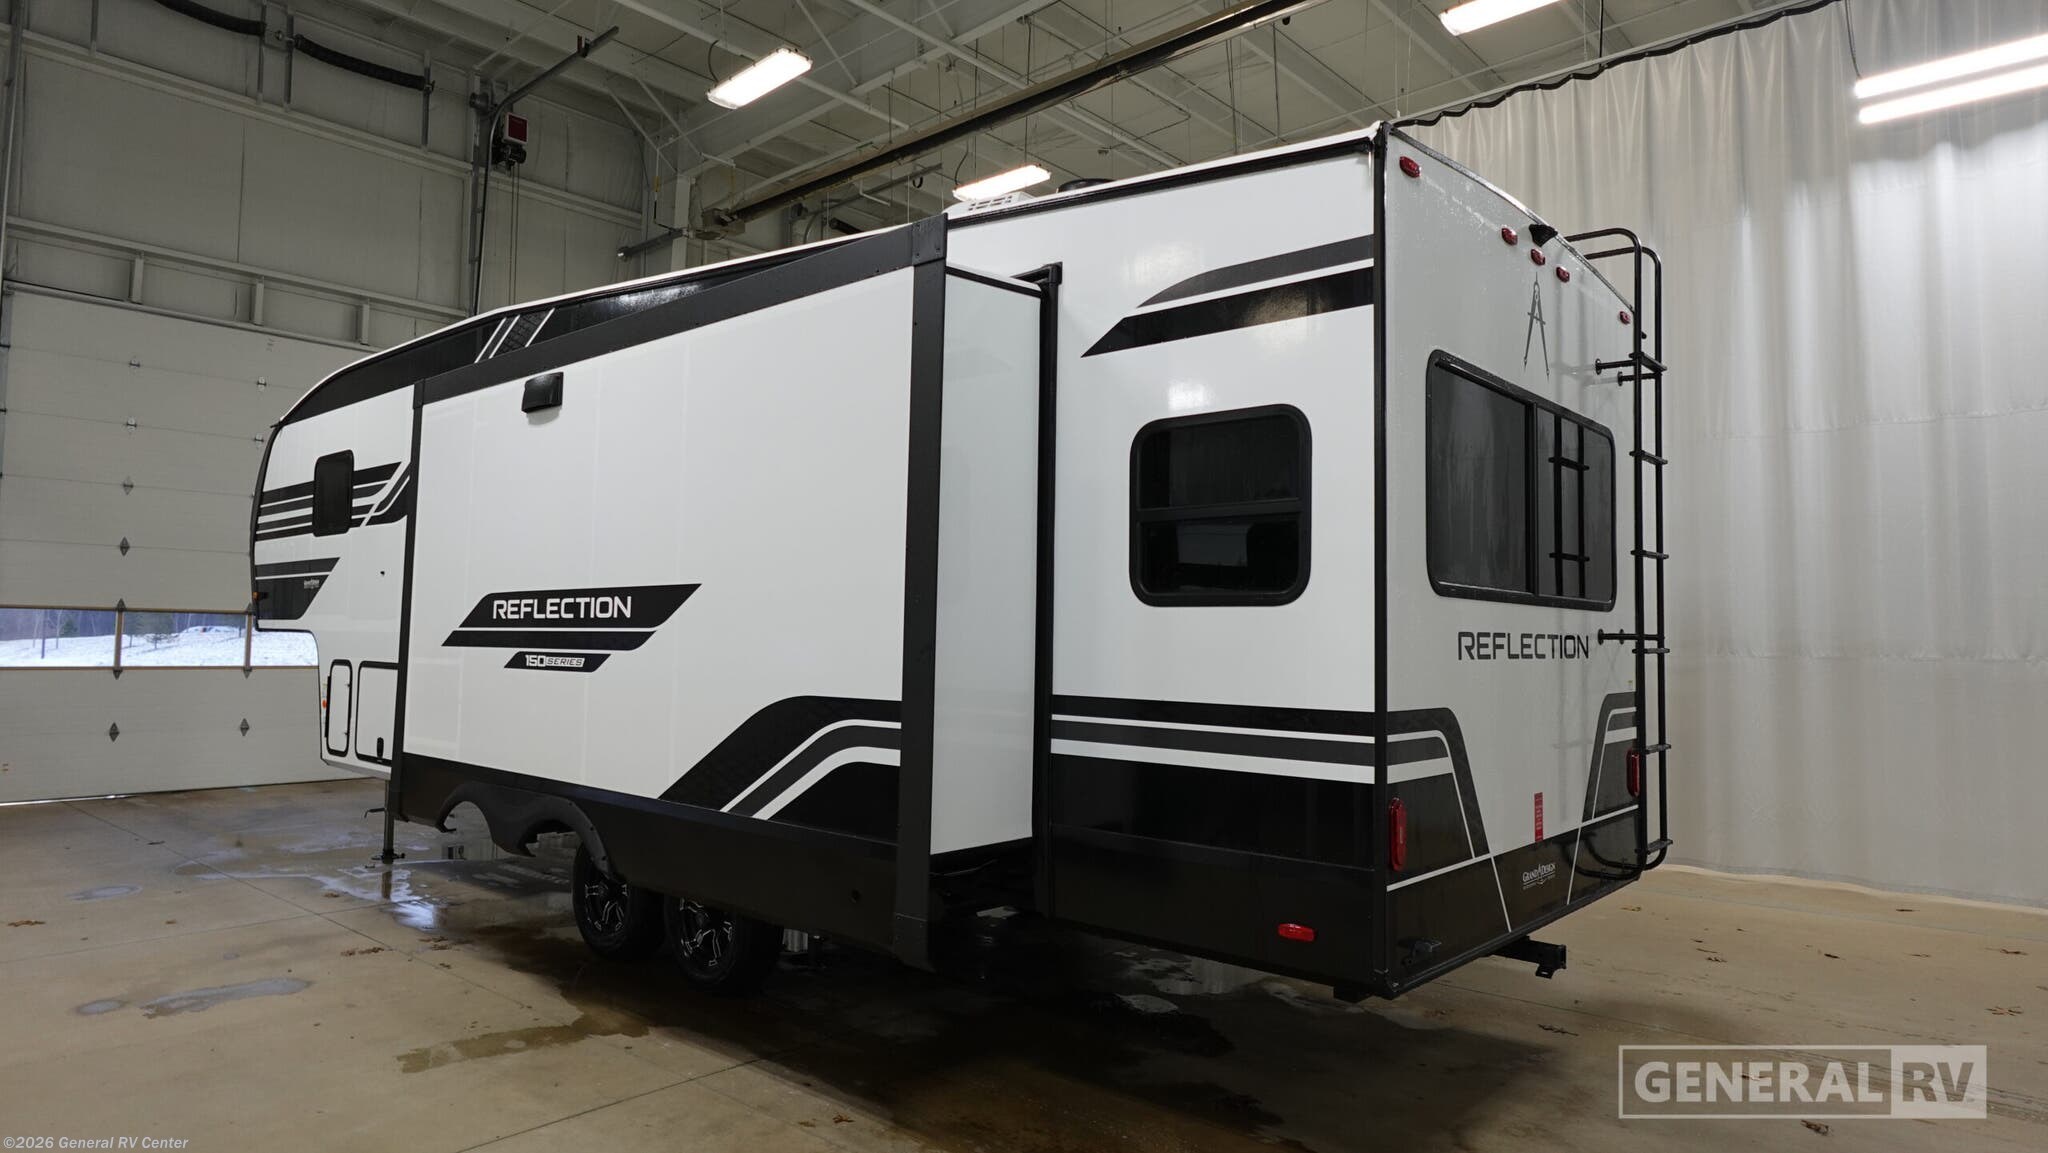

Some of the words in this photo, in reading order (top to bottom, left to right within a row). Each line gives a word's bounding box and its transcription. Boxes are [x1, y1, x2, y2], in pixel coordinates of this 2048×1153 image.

[492, 595, 632, 620] REFLECTION
[1457, 631, 1589, 661] REFLECTION
[525, 654, 546, 667] 150
[547, 657, 584, 667] SERIES
